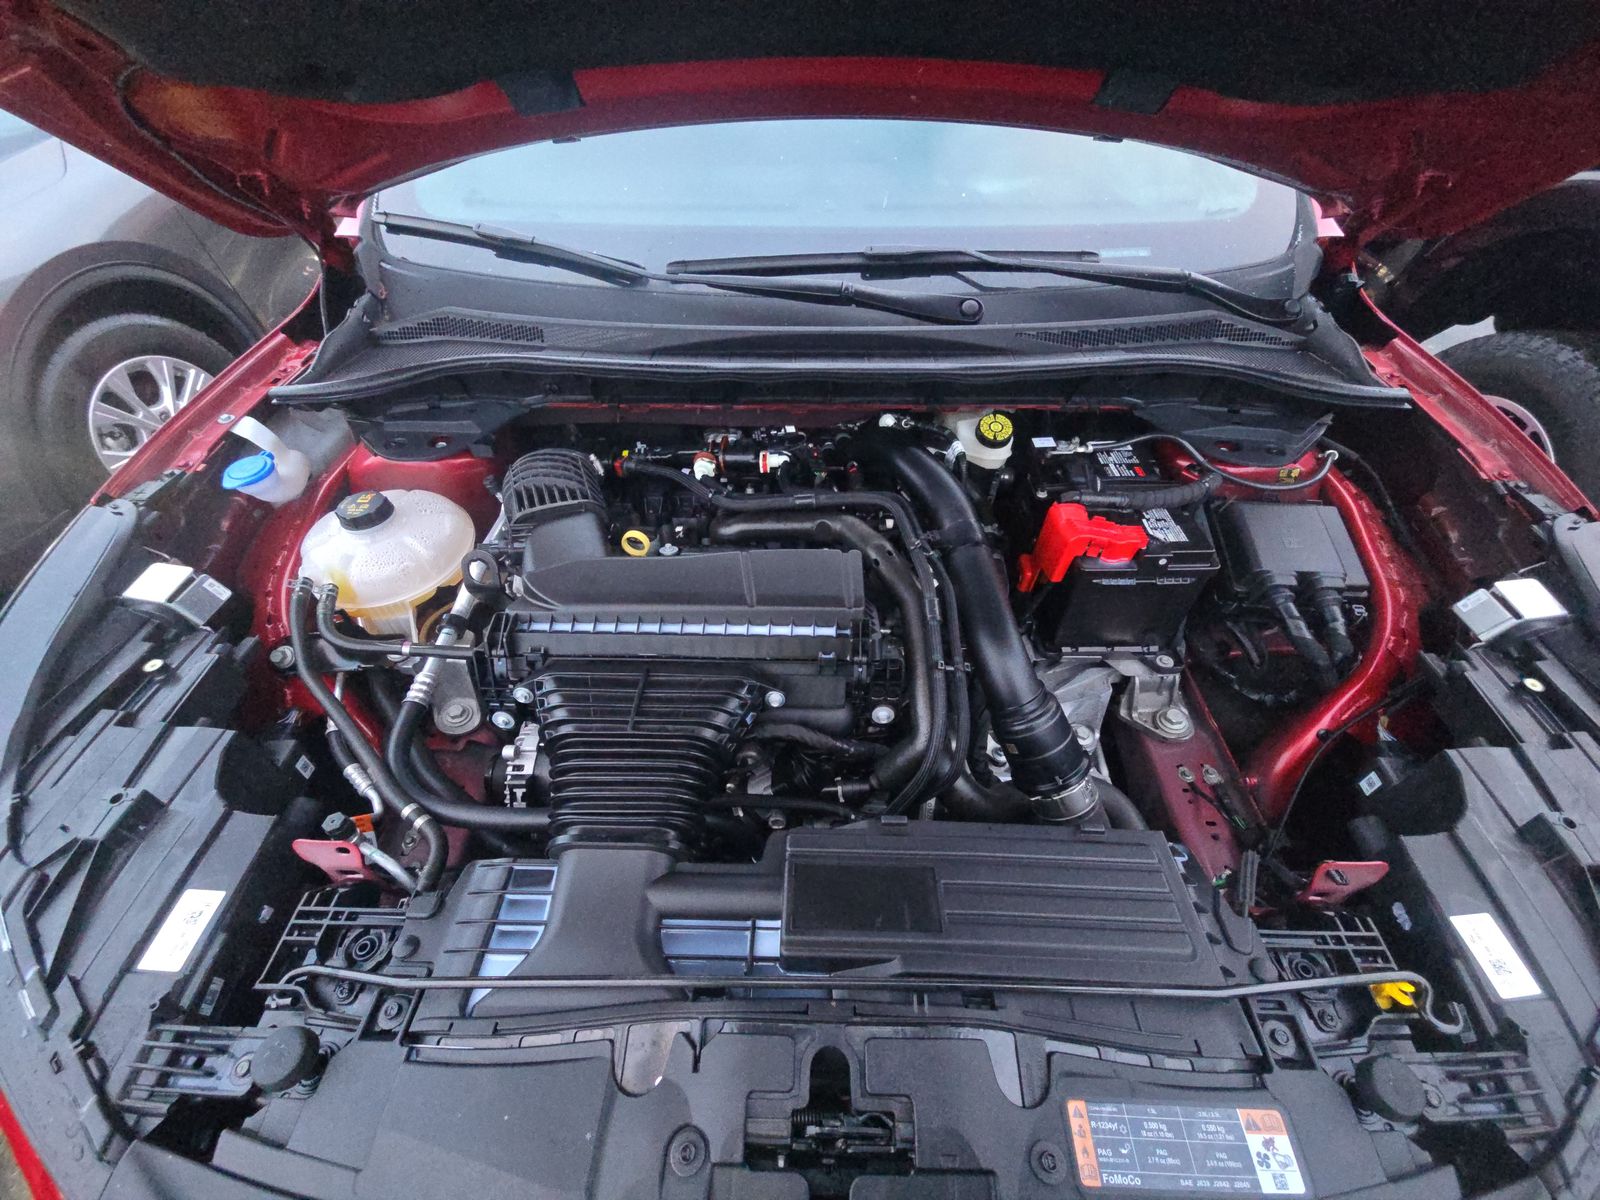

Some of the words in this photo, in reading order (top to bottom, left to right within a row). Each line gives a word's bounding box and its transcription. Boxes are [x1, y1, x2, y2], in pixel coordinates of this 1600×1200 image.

[1090, 1120, 1118, 1131] R-1234yf
[1158, 1122, 1167, 1132] kg
[1216, 1125, 1225, 1134] kg
[1097, 1148, 1112, 1156] PAG
[1102, 1173, 1141, 1185] FoMoCo
